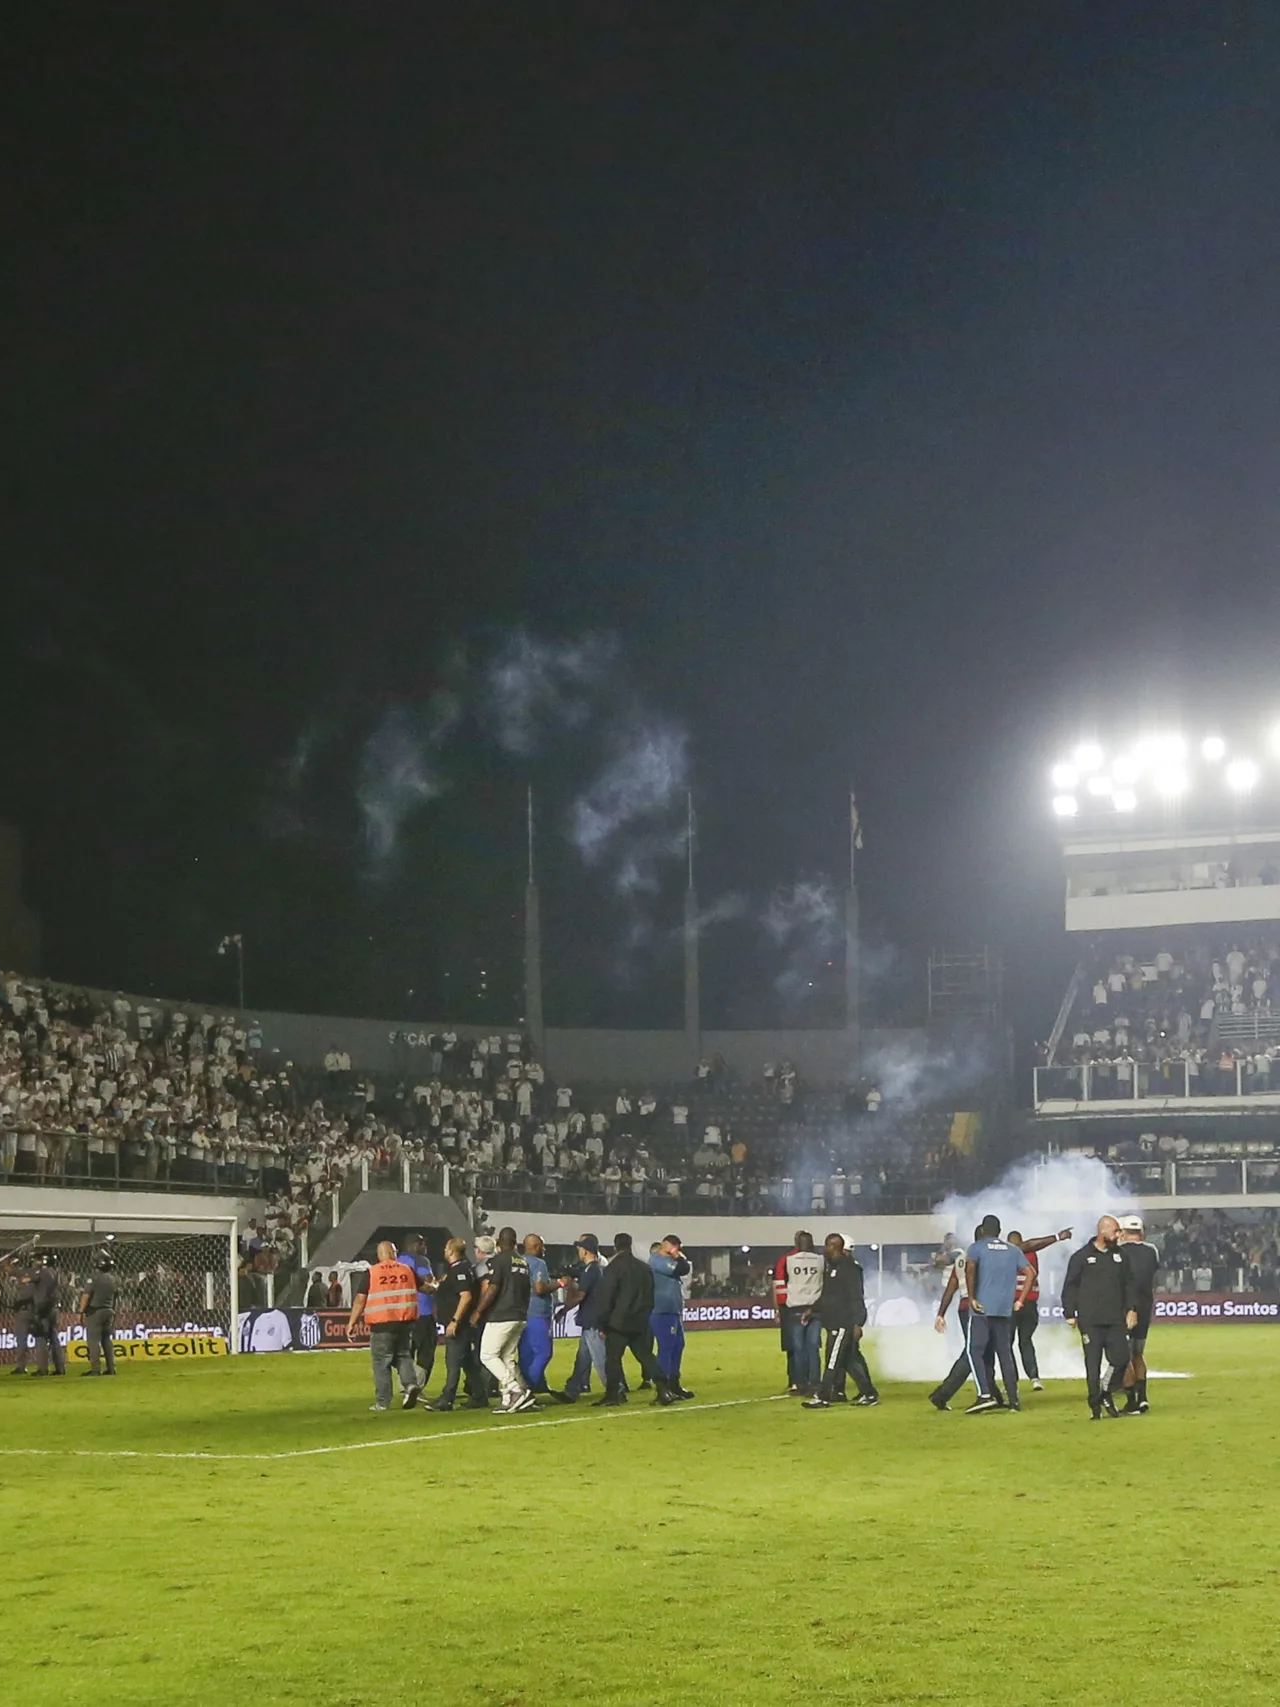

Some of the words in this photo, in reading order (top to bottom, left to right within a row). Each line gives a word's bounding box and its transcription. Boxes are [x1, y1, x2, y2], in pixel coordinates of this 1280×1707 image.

[793, 1266, 818, 1275] 015
[379, 1274, 409, 1285] 229
[700, 1306, 731, 1320] 2023
[732, 1309, 749, 1320] na
[1155, 1303, 1197, 1316] 2023
[1201, 1305, 1220, 1316] na
[1223, 1301, 1278, 1315] Santos
